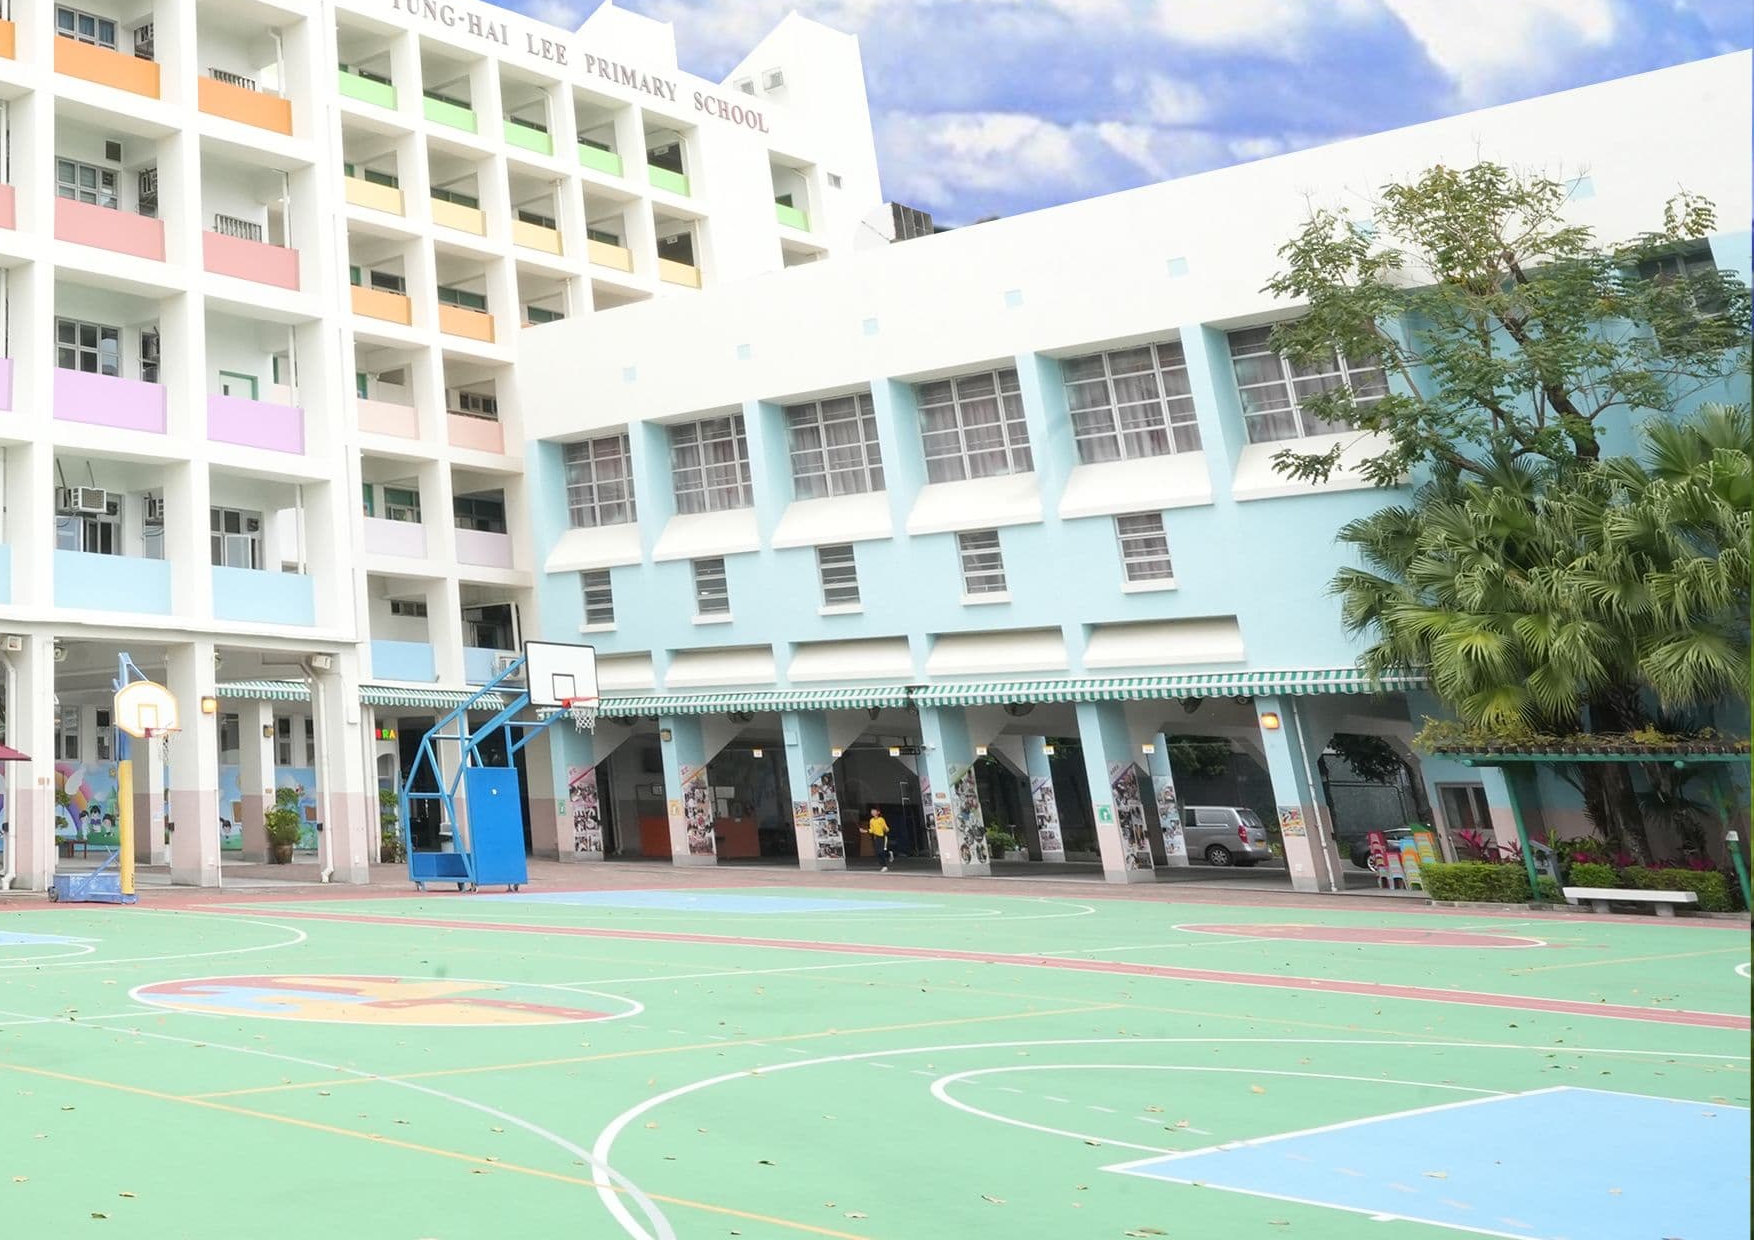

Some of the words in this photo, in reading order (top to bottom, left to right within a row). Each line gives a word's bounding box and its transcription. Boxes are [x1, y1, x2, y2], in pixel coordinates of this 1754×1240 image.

[526, 32, 568, 66] LEE
[585, 52, 677, 102] PRIMARY
[693, 91, 769, 134] SCHOOL
